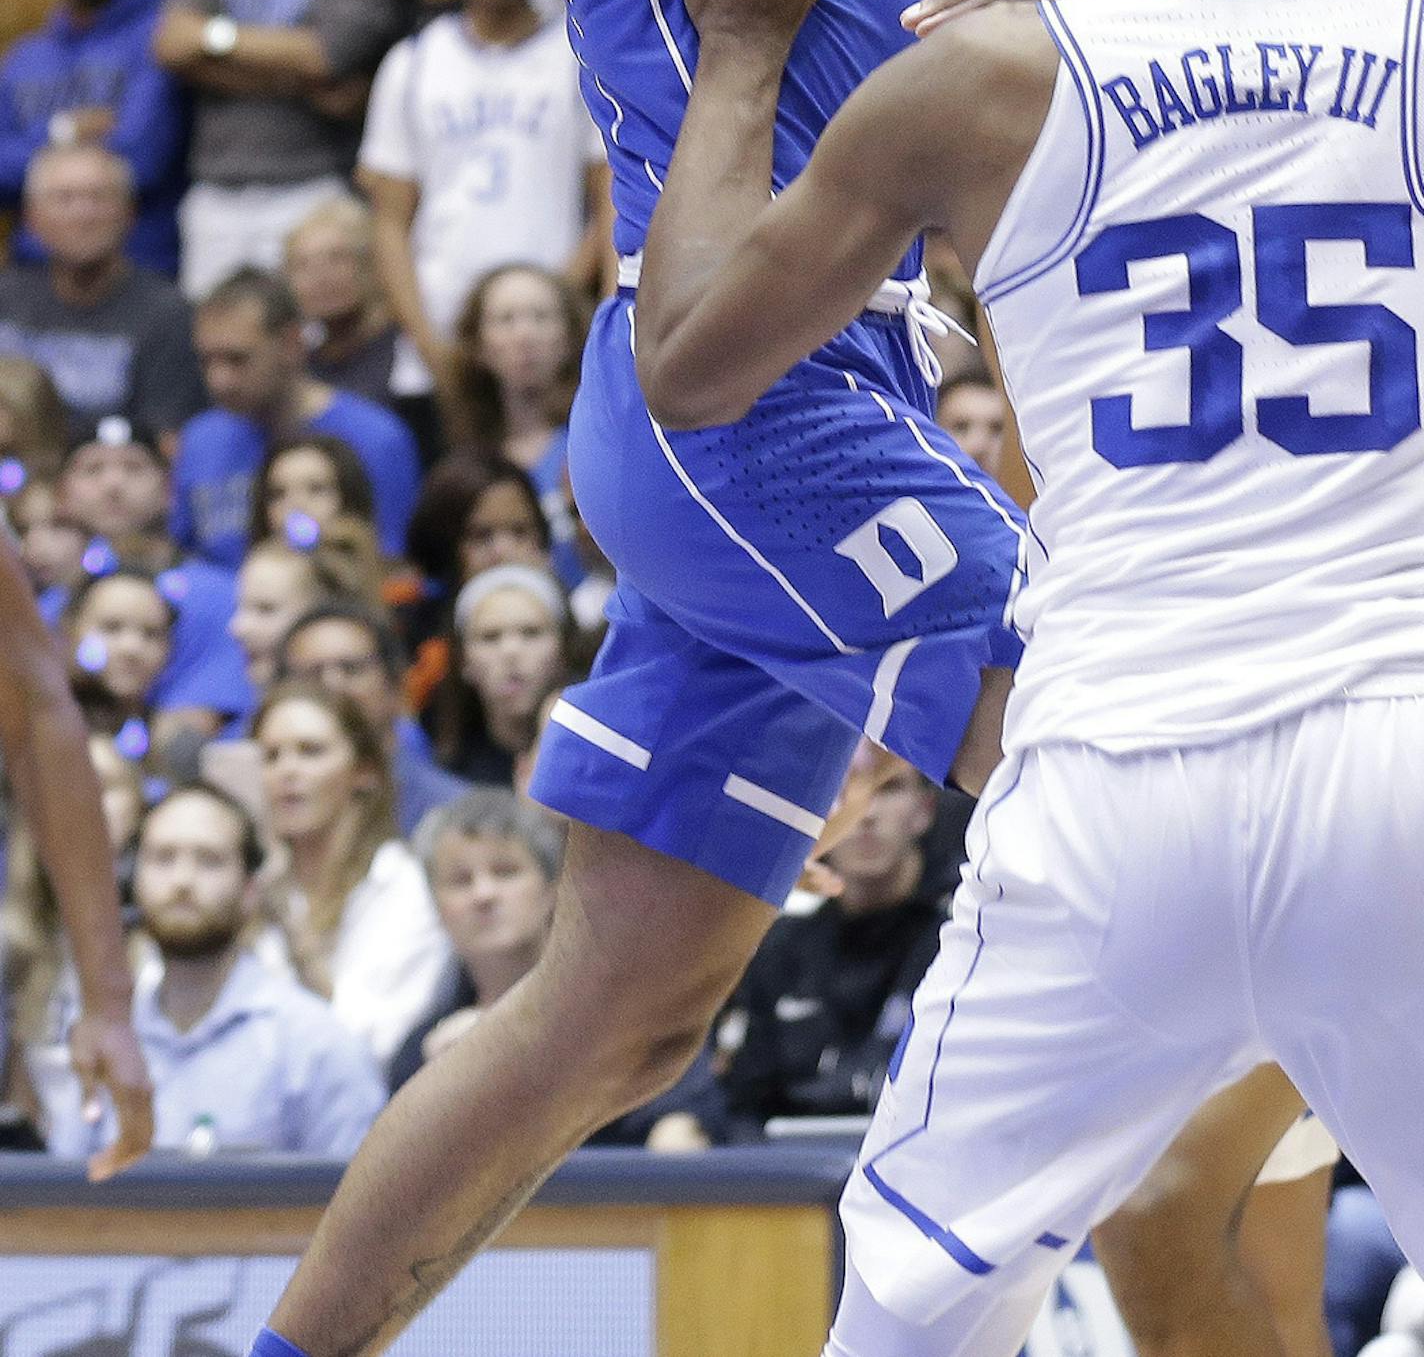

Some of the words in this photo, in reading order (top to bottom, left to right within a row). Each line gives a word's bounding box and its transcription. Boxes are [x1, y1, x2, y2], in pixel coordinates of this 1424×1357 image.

[1101, 42, 1323, 152] BAGLEY
[1328, 46, 1401, 130] III
[1074, 202, 1422, 471] 35
[832, 495, 960, 620] D
